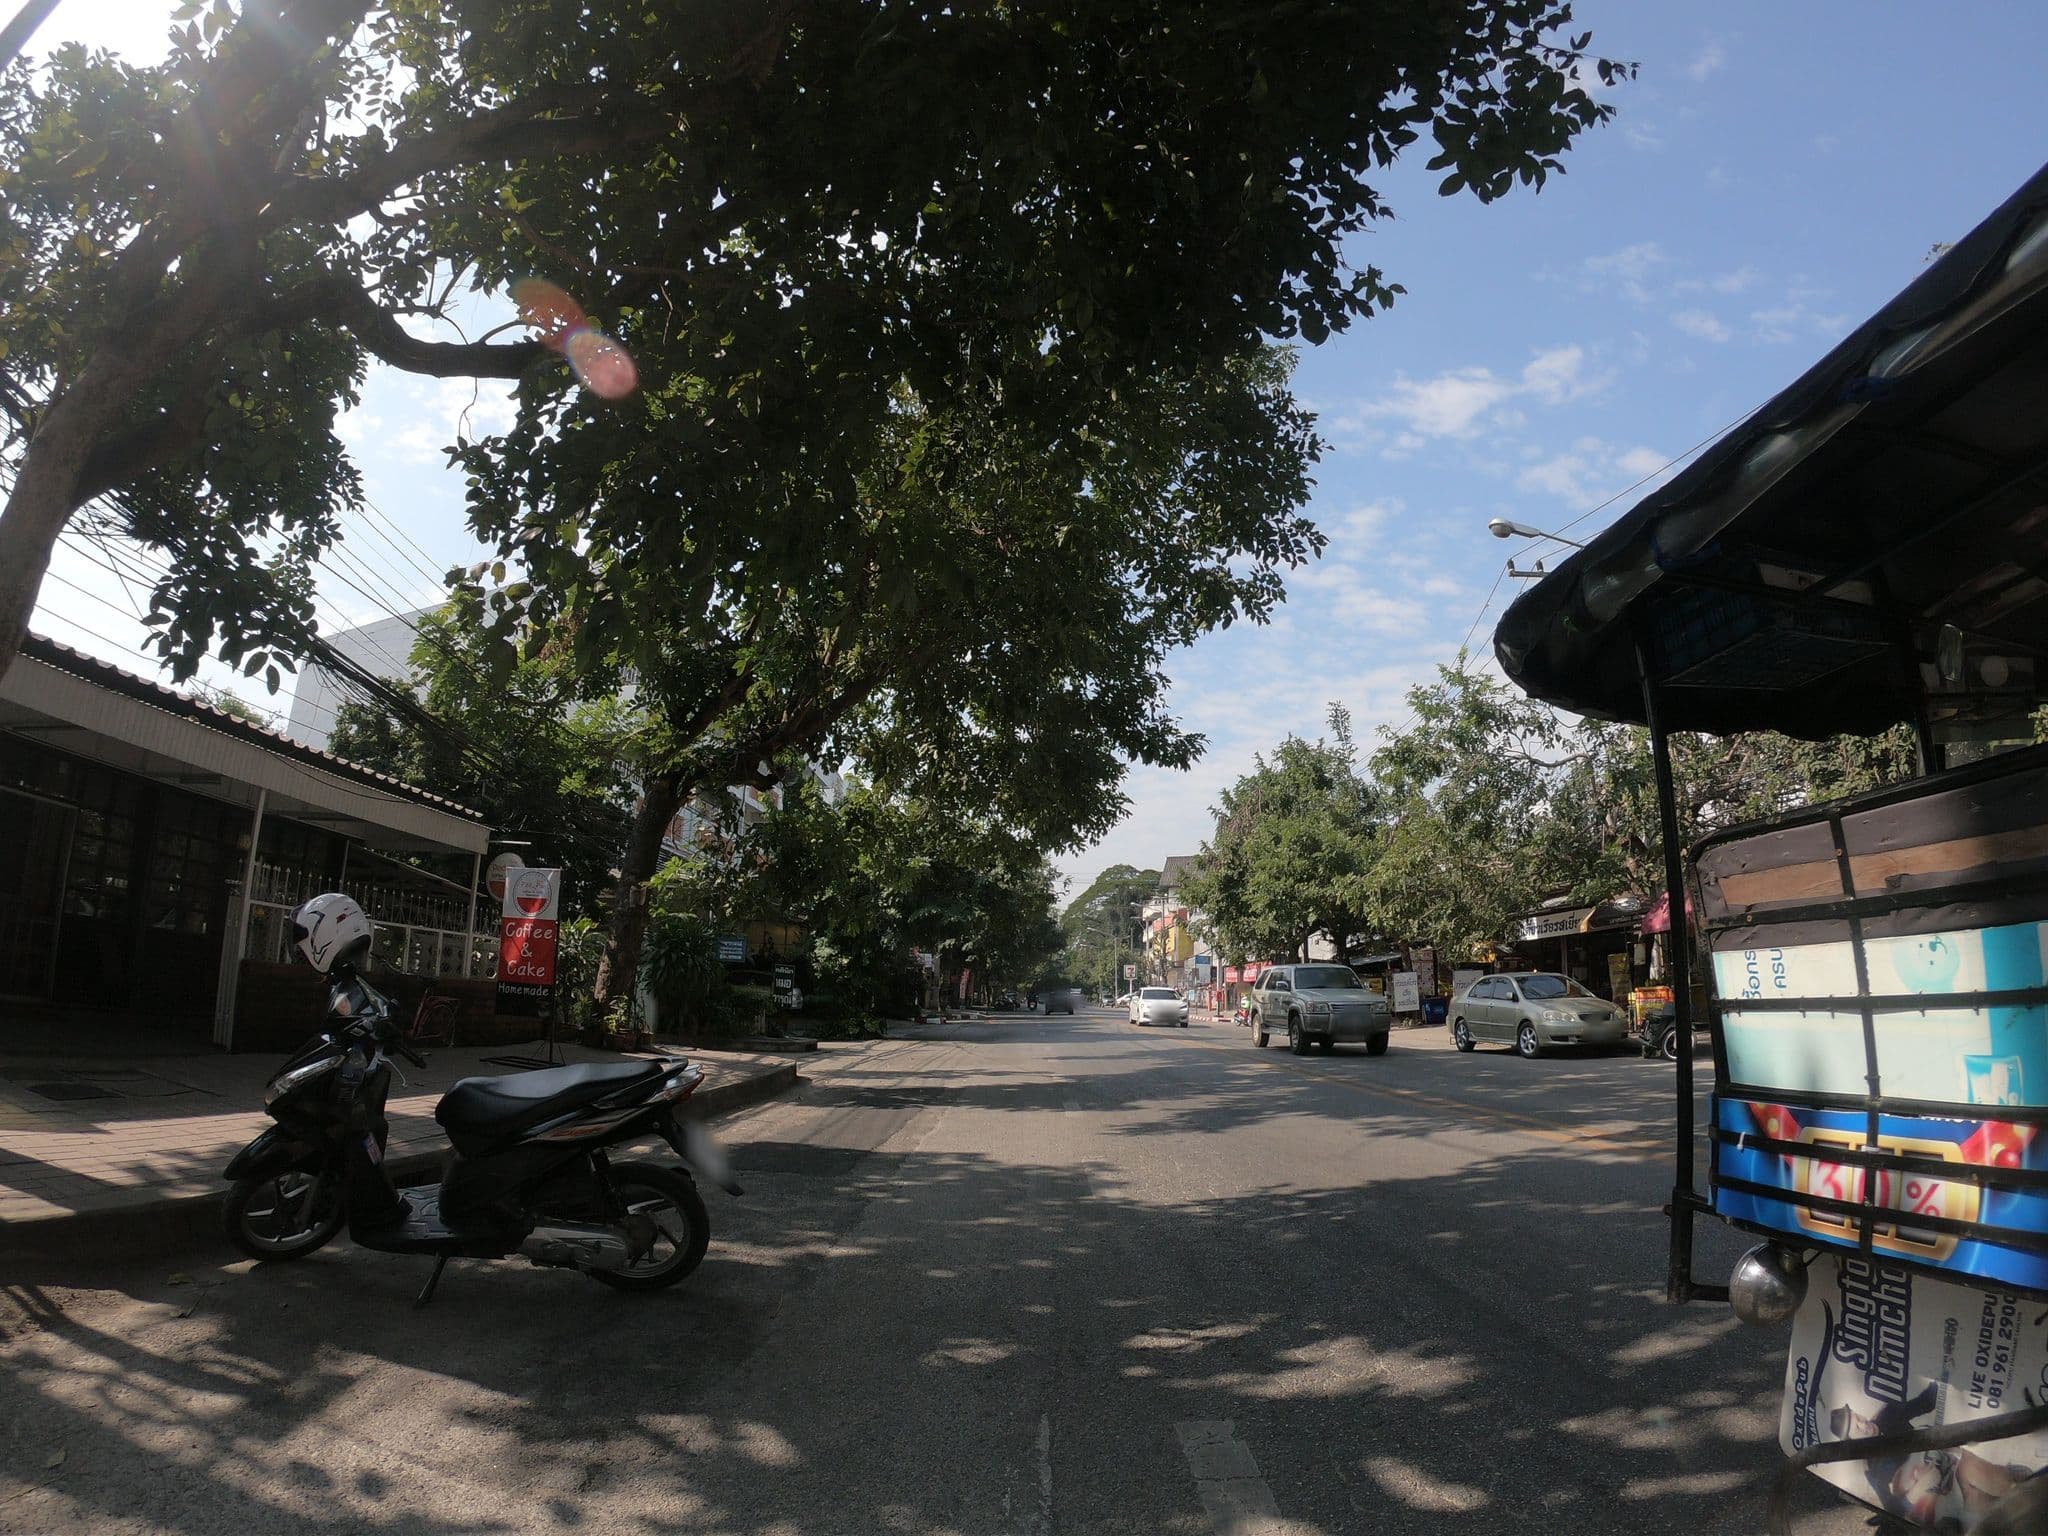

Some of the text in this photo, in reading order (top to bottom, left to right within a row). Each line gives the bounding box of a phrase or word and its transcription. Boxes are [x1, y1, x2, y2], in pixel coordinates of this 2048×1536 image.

[505, 922, 553, 939] Coffee
[520, 942, 533, 957] &
[507, 960, 545, 977] Cake
[498, 983, 549, 996] Homemade
[1836, 1258, 1876, 1366] Singto
[1993, 1344, 2010, 1373] 961
[1794, 1358, 1808, 1450] OxidePub
[1968, 1371, 1986, 1409] LIVE
[1987, 1379, 2004, 1409] 081
